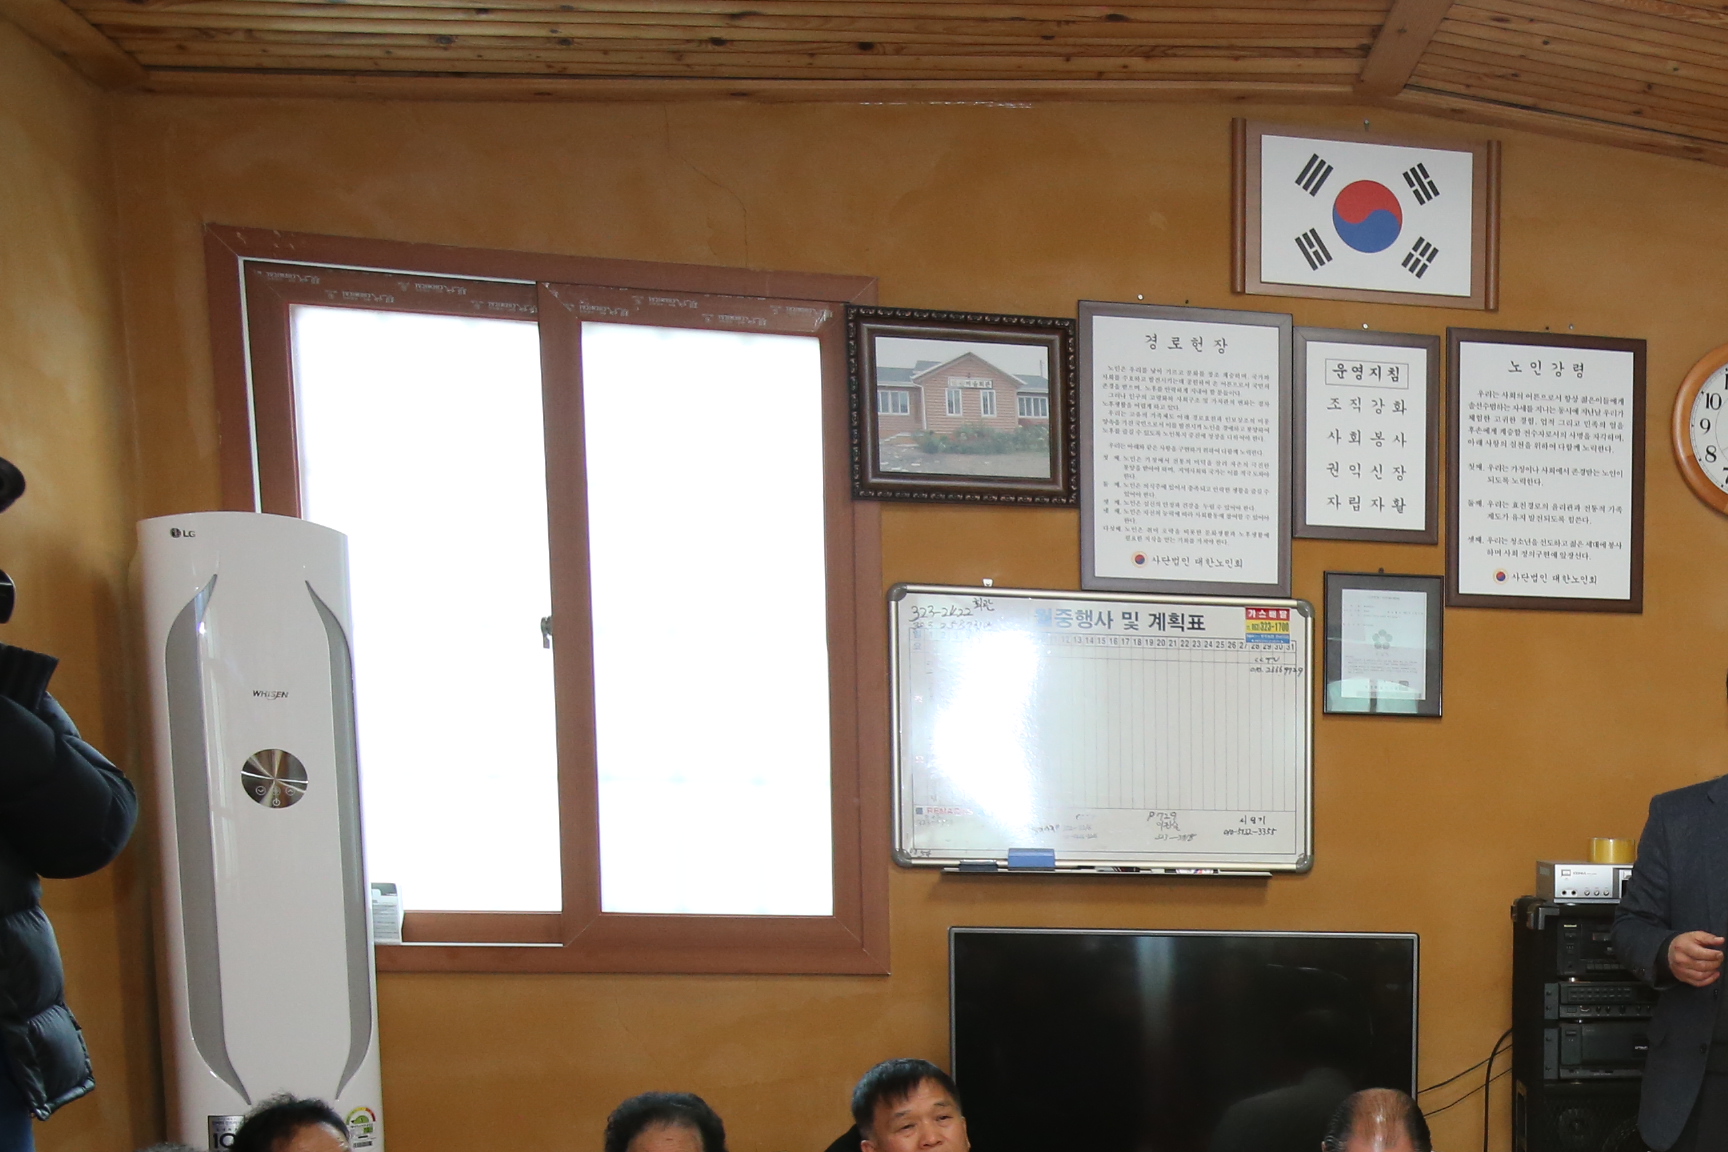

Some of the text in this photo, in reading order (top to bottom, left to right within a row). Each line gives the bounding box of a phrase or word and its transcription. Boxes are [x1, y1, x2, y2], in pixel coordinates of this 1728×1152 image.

[1145, 334, 1228, 354] 경로헌장
[1332, 363, 1400, 382] 운영지침
[1508, 360, 1585, 378] 노인강령
[1327, 397, 1407, 416] 조직강화
[1705, 393, 1722, 410] 10
[1700, 418, 1711, 434] 9
[1327, 428, 1407, 448] 사회봉사
[1705, 445, 1717, 462] 8
[1326, 462, 1406, 481] 권익신장
[1327, 494, 1406, 514] 자립자활
[182, 530, 196, 538] LG
[1152, 555, 1243, 569] 사단법인 대한노인회
[1512, 572, 1597, 585] 사단법인 대한노인회
[1122, 611, 1139, 631] 및
[1148, 611, 1206, 633] 계획표
[1248, 609, 1288, 619] 가스배달
[1074, 636, 1082, 644] 13
[1097, 637, 1106, 645] 15
[1109, 637, 1118, 645] 16
[1121, 638, 1130, 646] 17
[1133, 638, 1142, 646] 18
[1157, 639, 1166, 647] 20
[1168, 639, 1177, 647] 21
[1180, 640, 1190, 648] 22
[1192, 640, 1201, 648] 23
[1216, 641, 1225, 649] 25
[1228, 641, 1237, 649] 26
[252, 690, 289, 699] WHISEN
